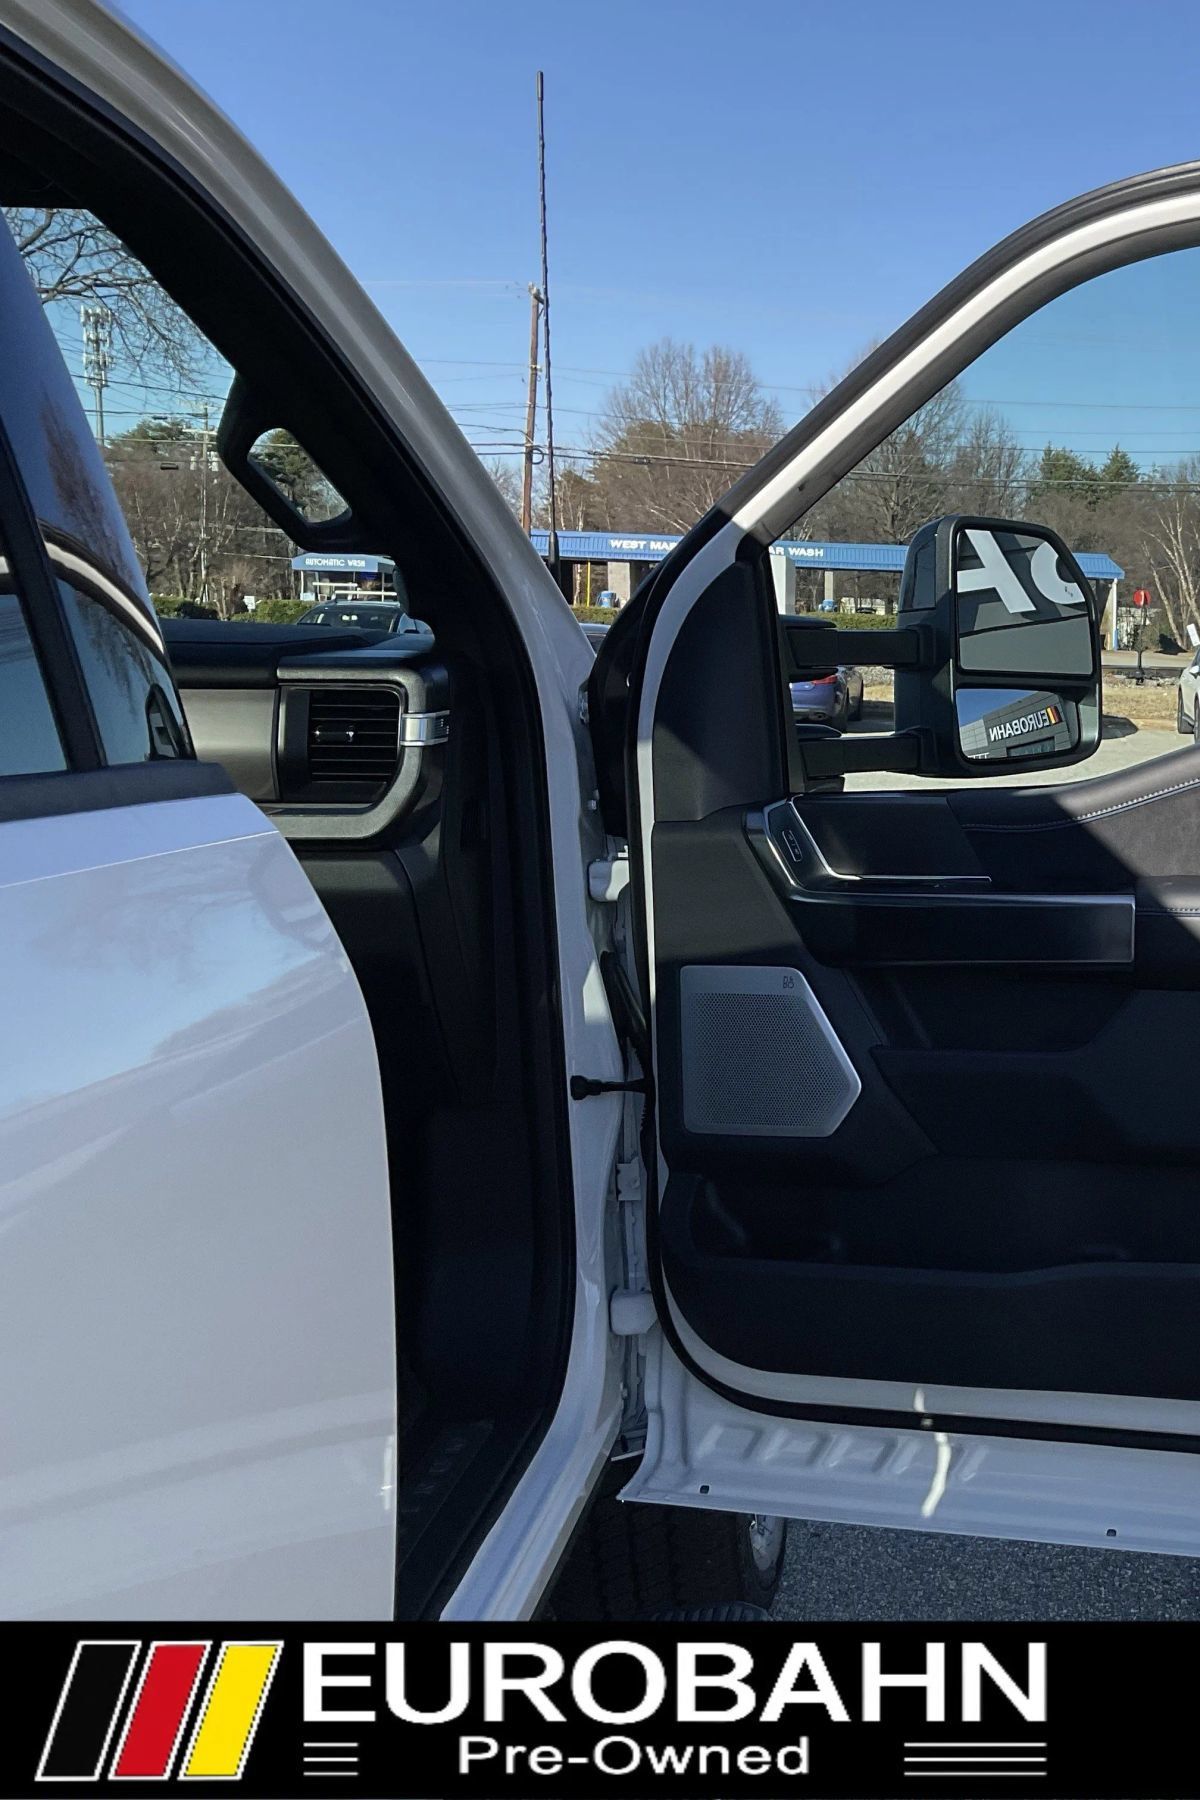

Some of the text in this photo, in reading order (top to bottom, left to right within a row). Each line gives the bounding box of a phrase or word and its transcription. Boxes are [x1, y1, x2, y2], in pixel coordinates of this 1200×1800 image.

[610, 539, 647, 551] WEST
[768, 545, 824, 557] AR WASH
[305, 558, 366, 568] AUTOMATIC WASH
